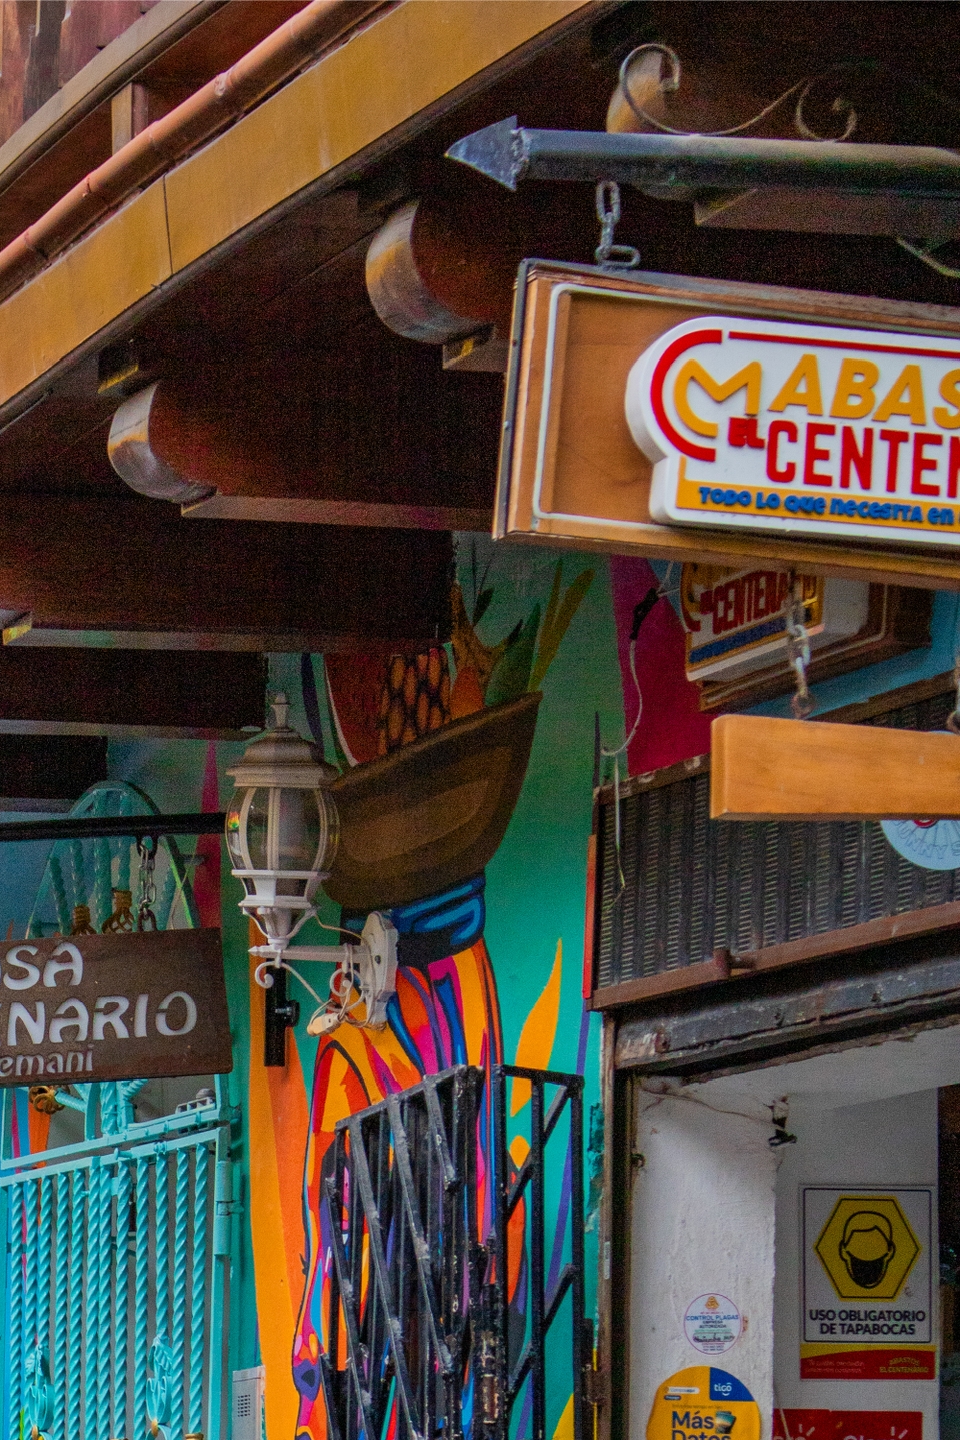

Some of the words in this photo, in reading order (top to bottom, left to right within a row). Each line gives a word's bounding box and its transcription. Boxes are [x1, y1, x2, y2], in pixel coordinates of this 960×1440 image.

[699, 486, 751, 508] TODO
[756, 492, 780, 509] LO
[809, 1310, 836, 1321] USO
[838, 1310, 926, 1321] OBLIGATORIO
[820, 1323, 837, 1334] DE
[840, 1323, 915, 1335] TAPABOCAS
[714, 1382, 732, 1395] tigo
[671, 1410, 714, 1429] Más
